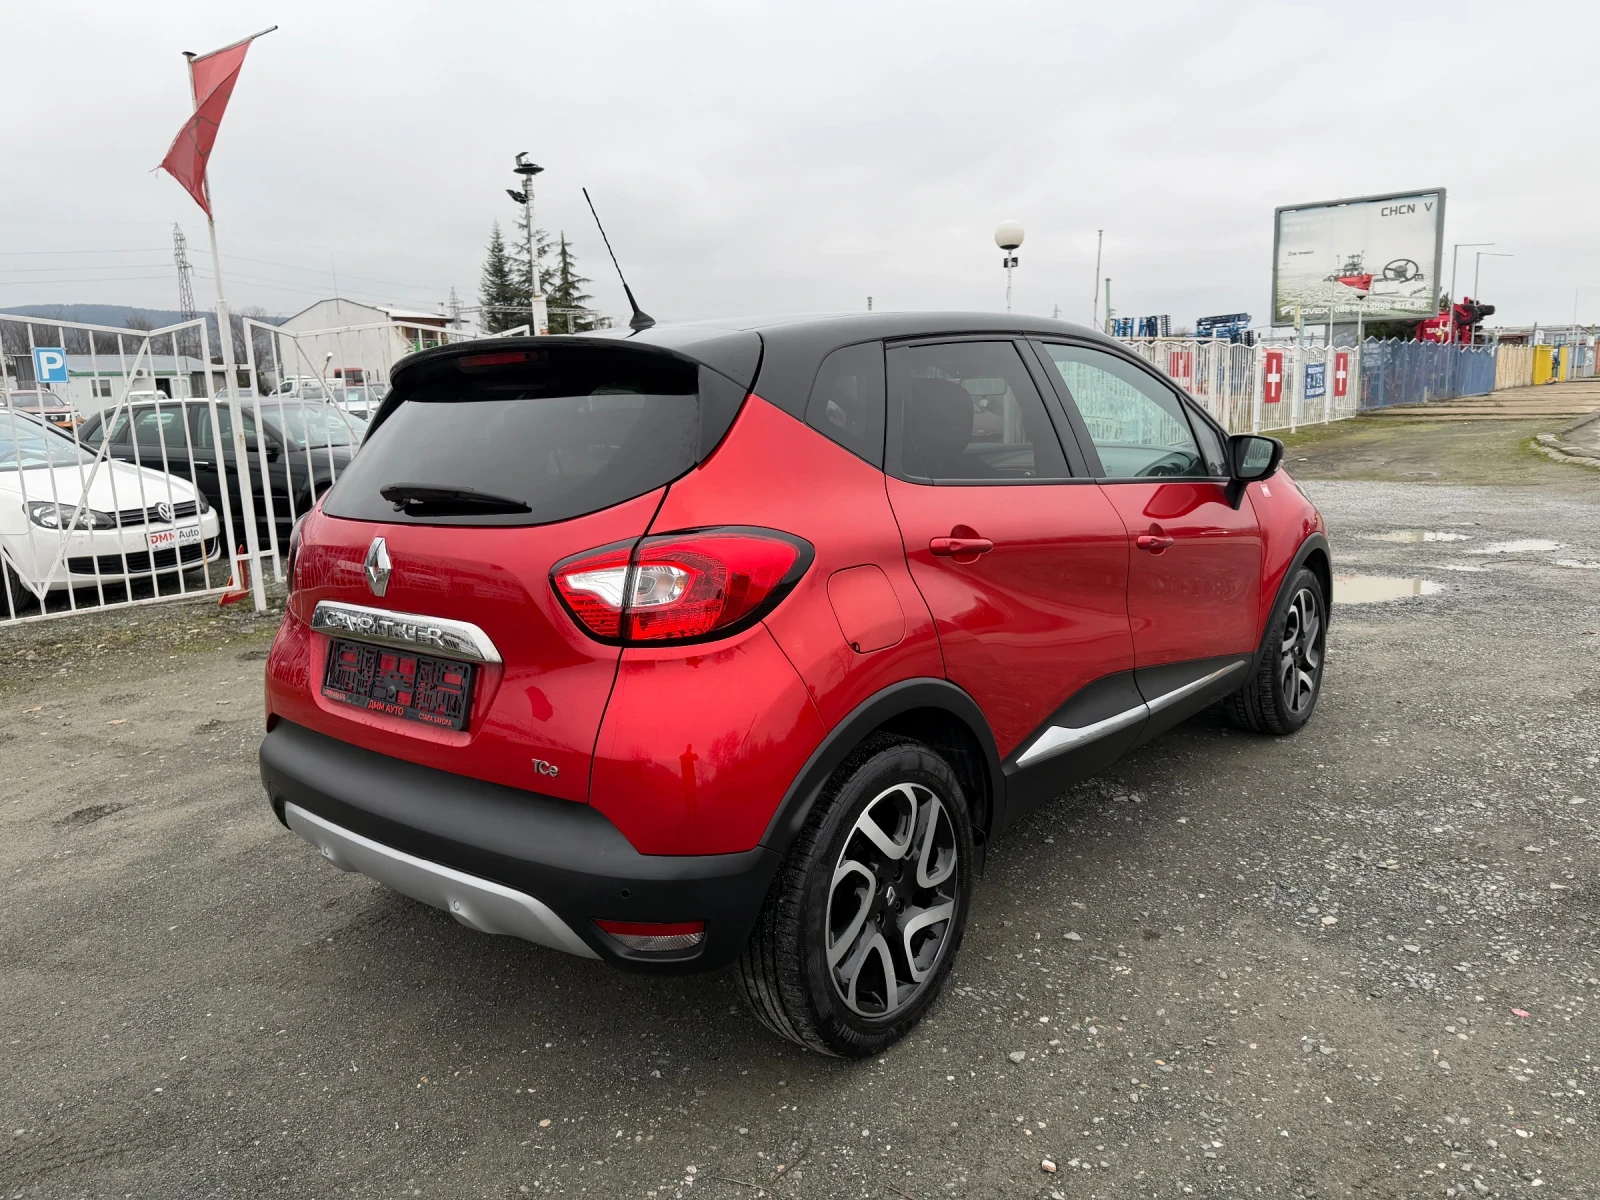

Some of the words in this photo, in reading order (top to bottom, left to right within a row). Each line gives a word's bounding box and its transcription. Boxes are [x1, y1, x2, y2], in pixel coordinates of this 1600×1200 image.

[1381, 203, 1416, 217] CHCN
[1424, 202, 1433, 212] V
[39, 351, 64, 379] P
[179, 528, 200, 539] Auto
[368, 700, 385, 711] ДММ
[385, 703, 404, 716] АУТО
[418, 713, 433, 723] СТАРА
[531, 758, 559, 777] TCe
